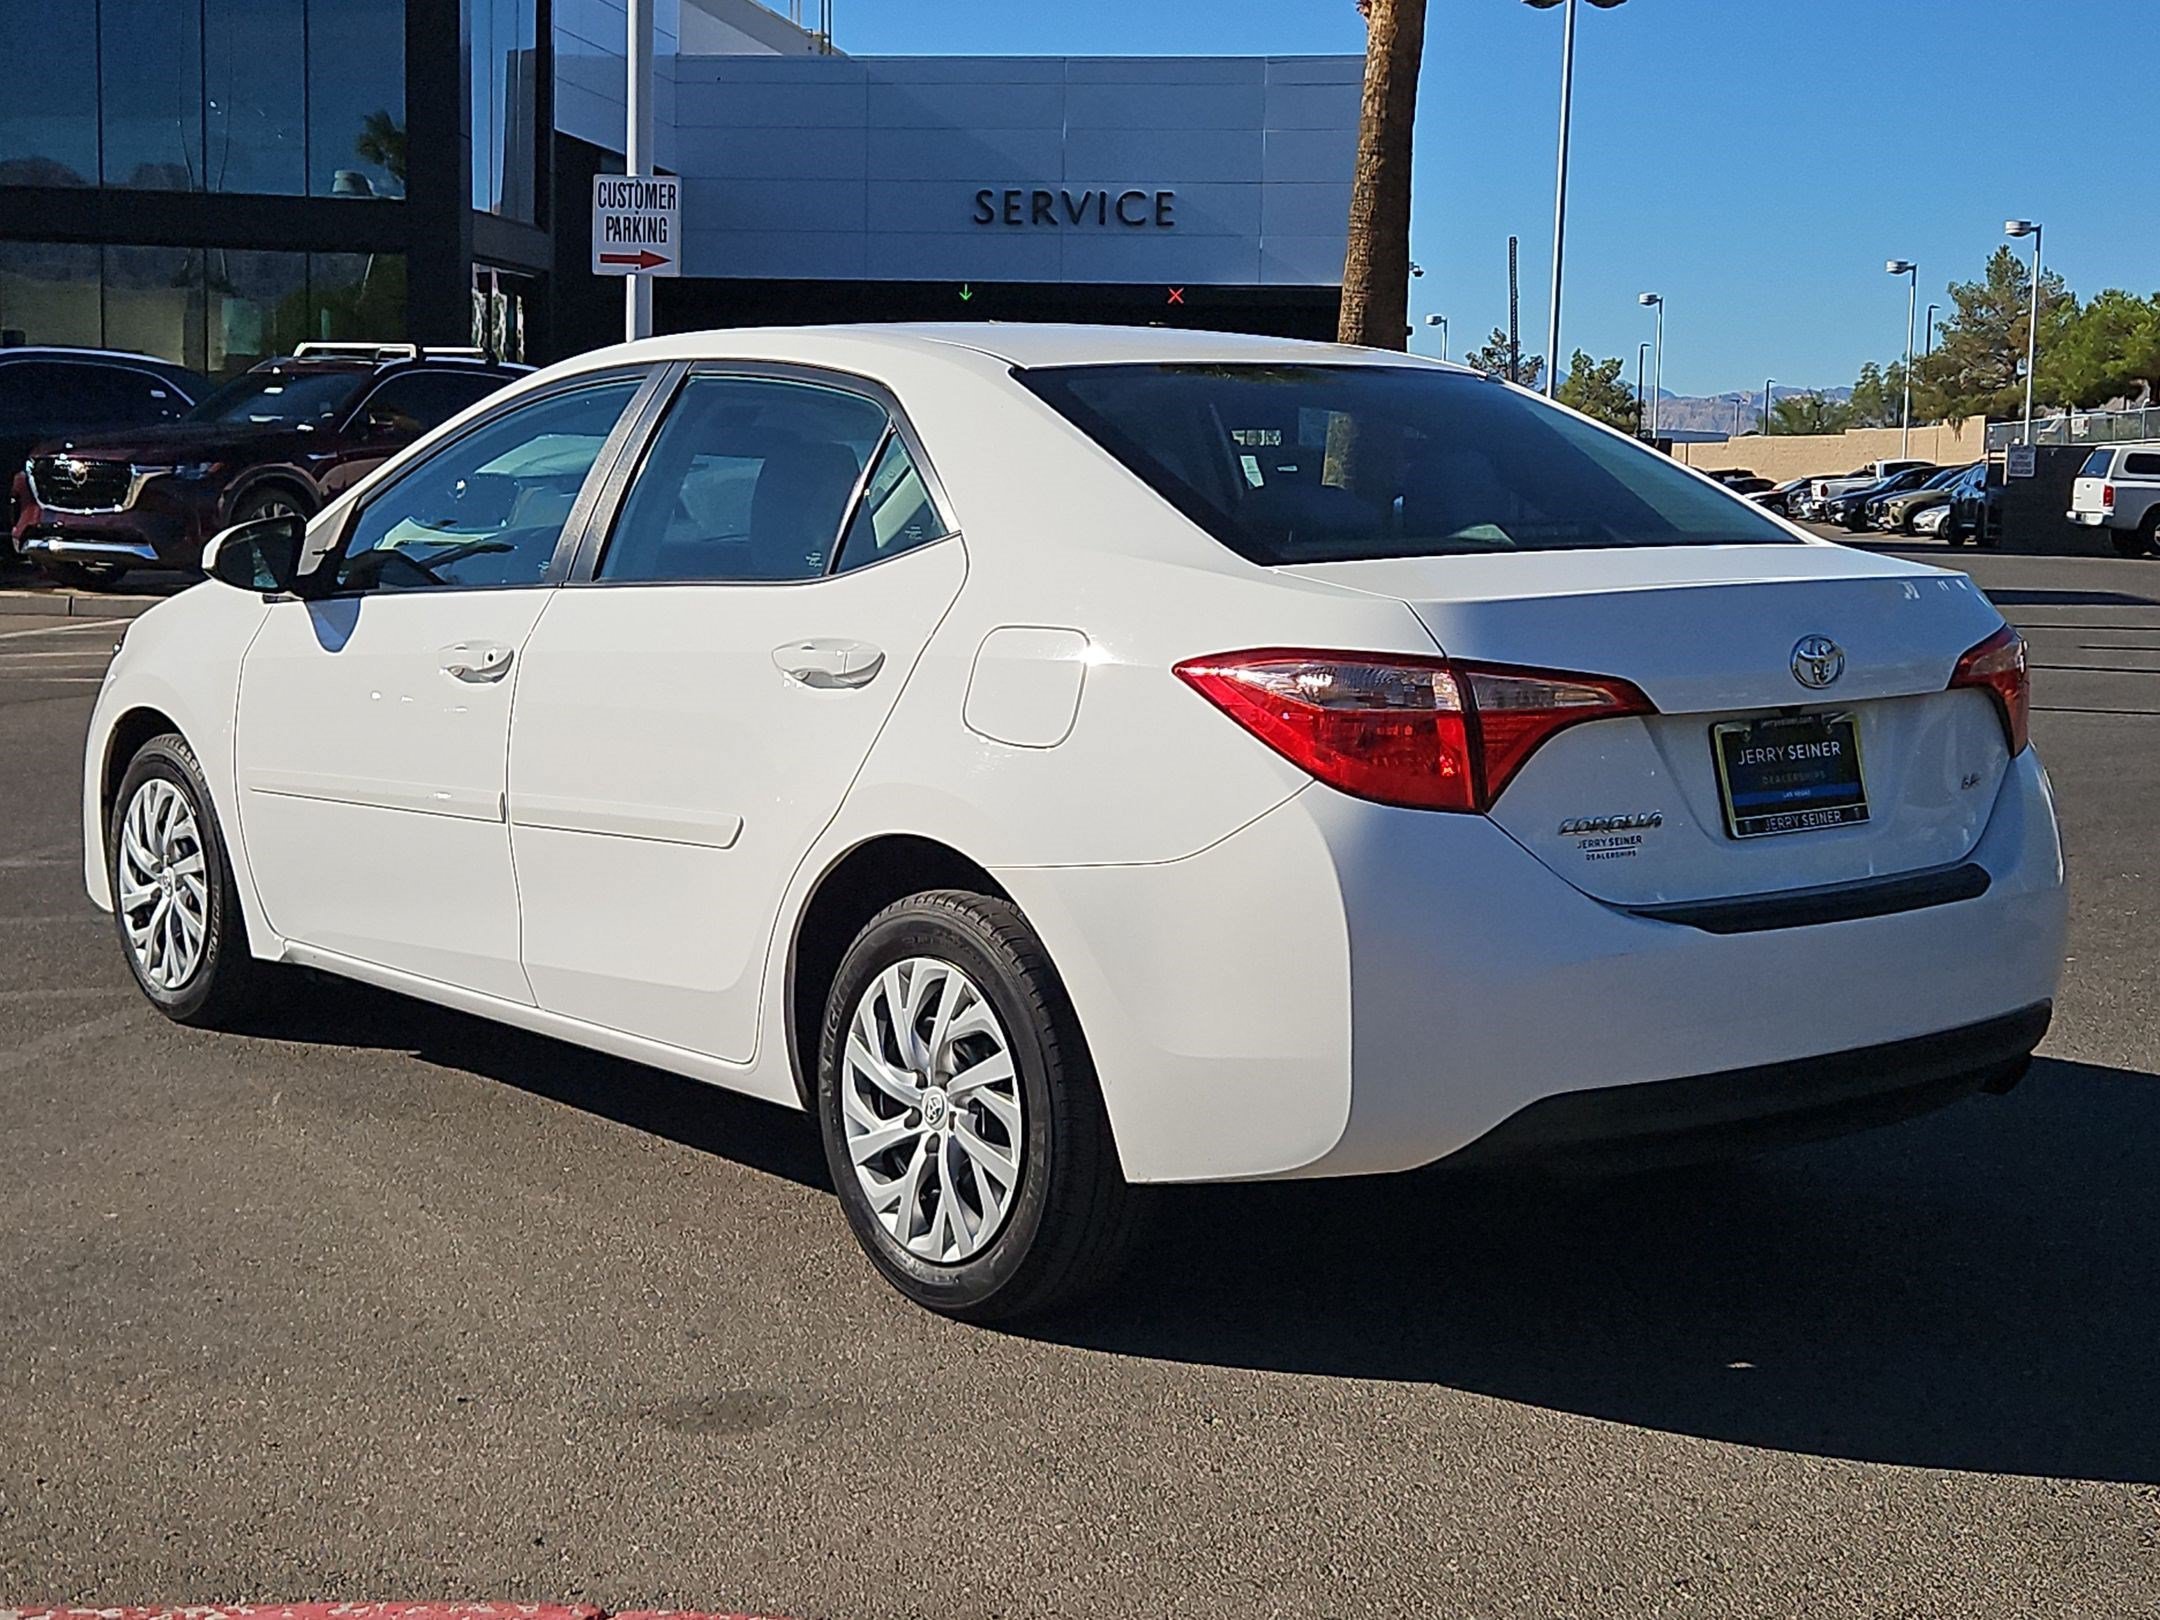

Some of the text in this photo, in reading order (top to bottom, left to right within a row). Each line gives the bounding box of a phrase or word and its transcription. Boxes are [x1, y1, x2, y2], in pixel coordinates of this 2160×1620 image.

[597, 180, 677, 210] CUSTOMER
[973, 188, 1175, 226] SERVICE
[605, 215, 667, 243] PARKING
[1738, 741, 1841, 766] JERRY SEINER
[1559, 810, 1663, 835] COROLLA
[1765, 810, 1842, 832] JERRY SEINER
[1577, 835, 1642, 849] JERRY SEINER
[1586, 850, 1637, 861] DEALERSHIPS
